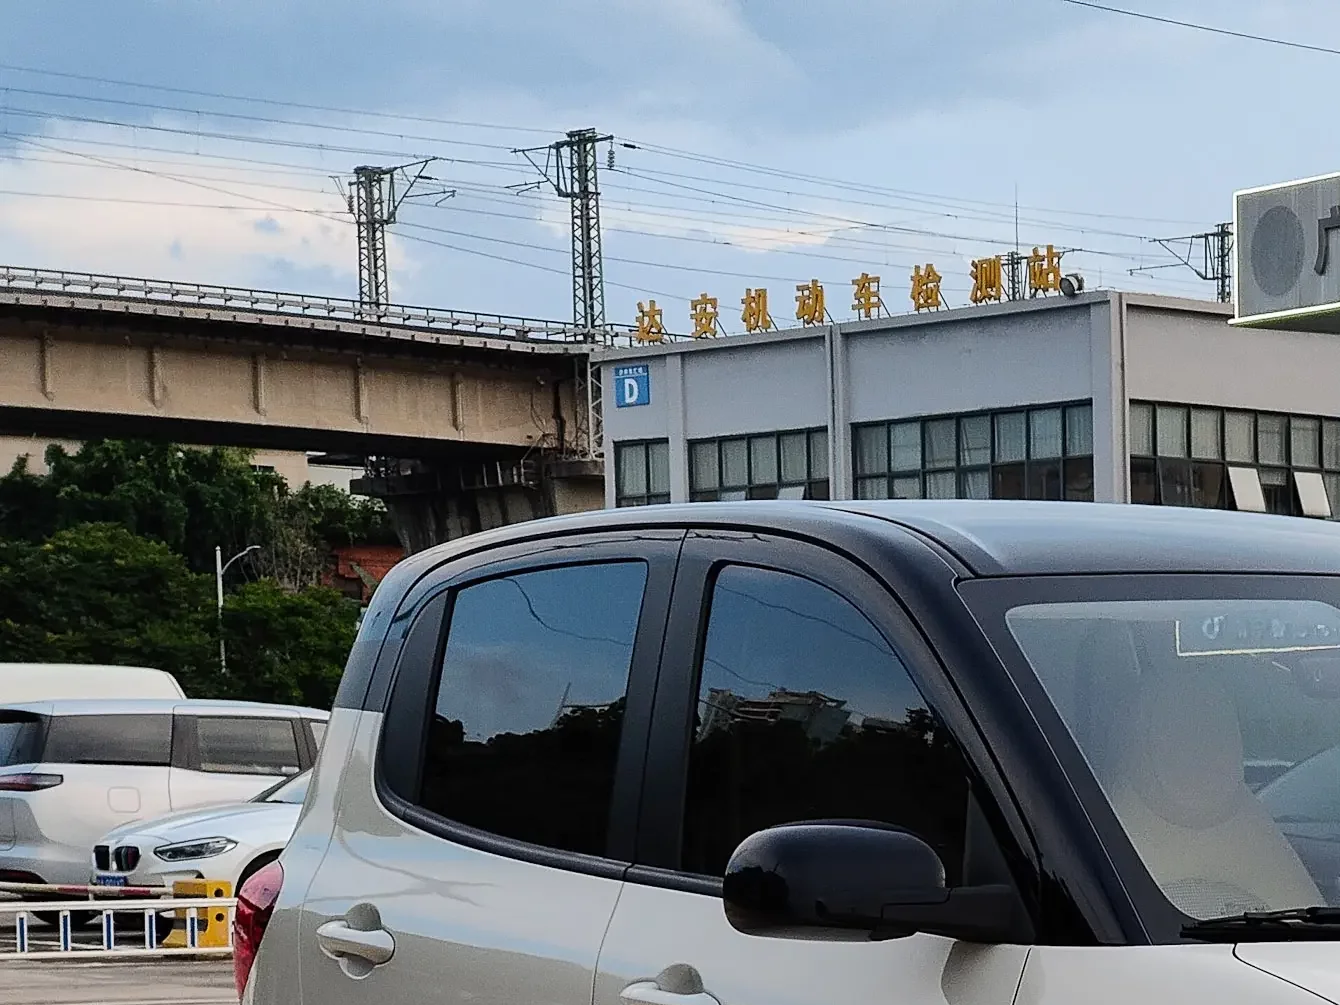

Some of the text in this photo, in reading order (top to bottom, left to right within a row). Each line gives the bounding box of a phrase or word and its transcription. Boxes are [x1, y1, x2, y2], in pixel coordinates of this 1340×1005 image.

[635, 244, 1061, 344] 达安机动车检测站
[624, 378, 639, 404] D
